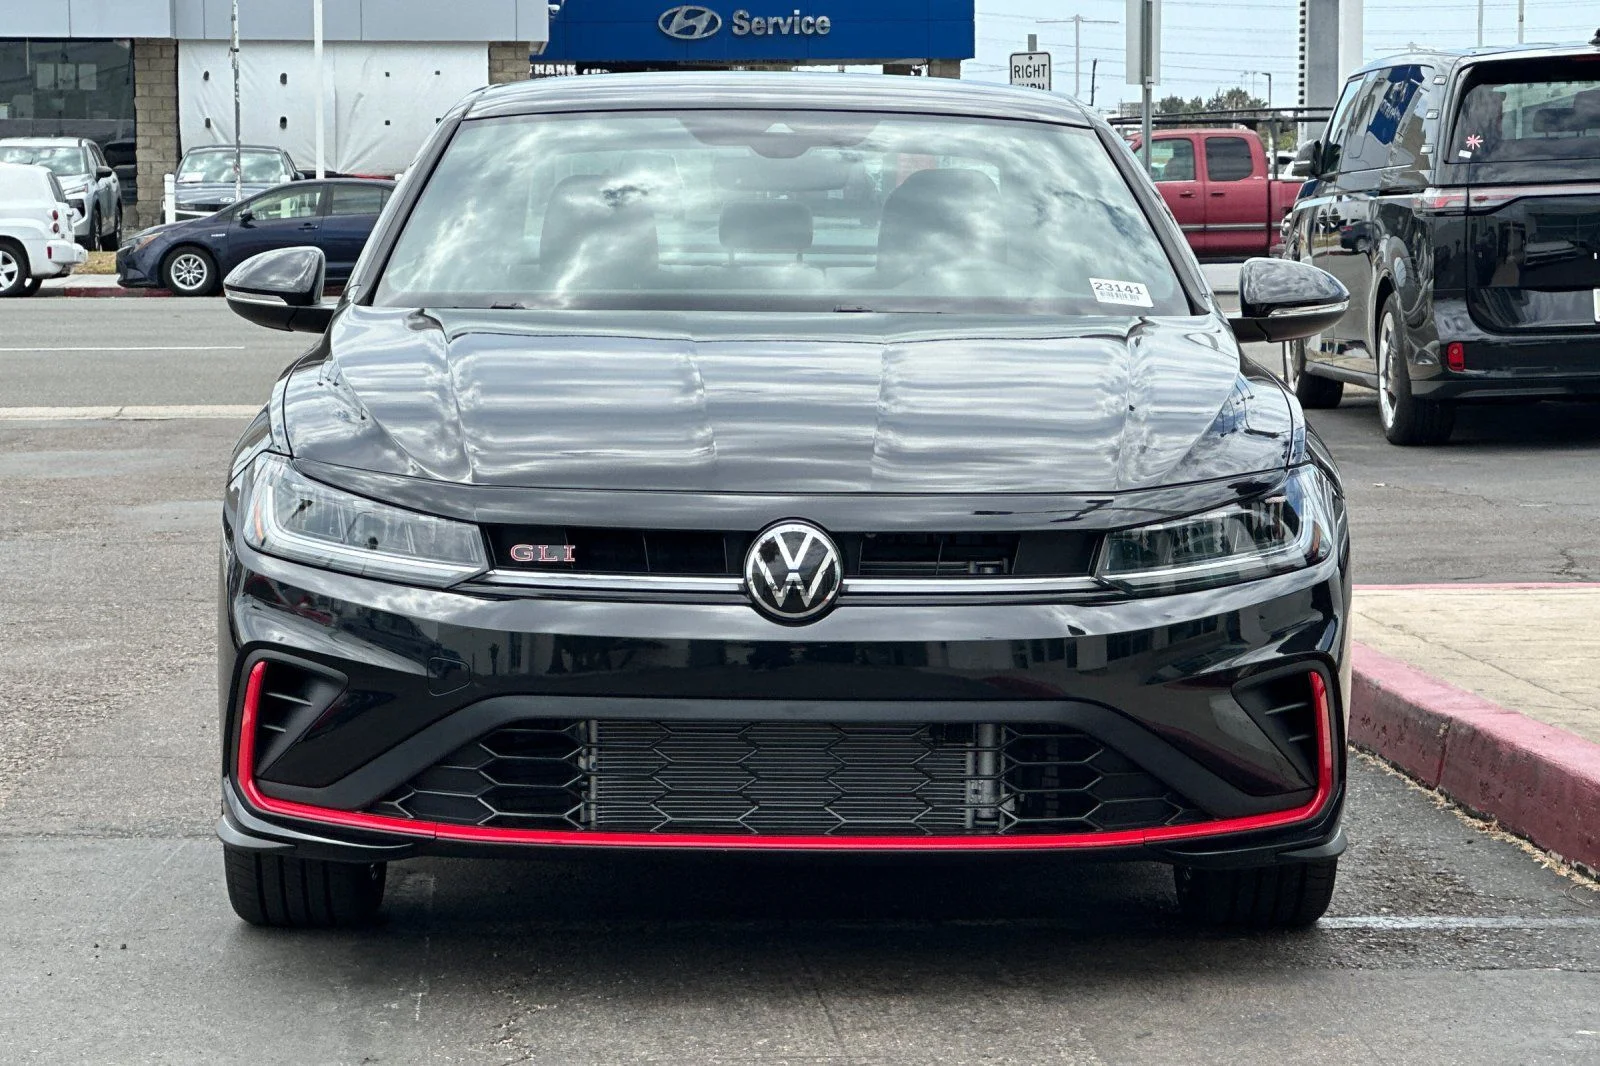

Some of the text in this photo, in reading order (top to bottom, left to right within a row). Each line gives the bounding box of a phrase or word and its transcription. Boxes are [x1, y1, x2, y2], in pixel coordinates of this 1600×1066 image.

[732, 9, 831, 36] Service
[1013, 63, 1047, 79] RIGHT
[1094, 282, 1143, 295] 23141
[510, 544, 576, 562] GLI
